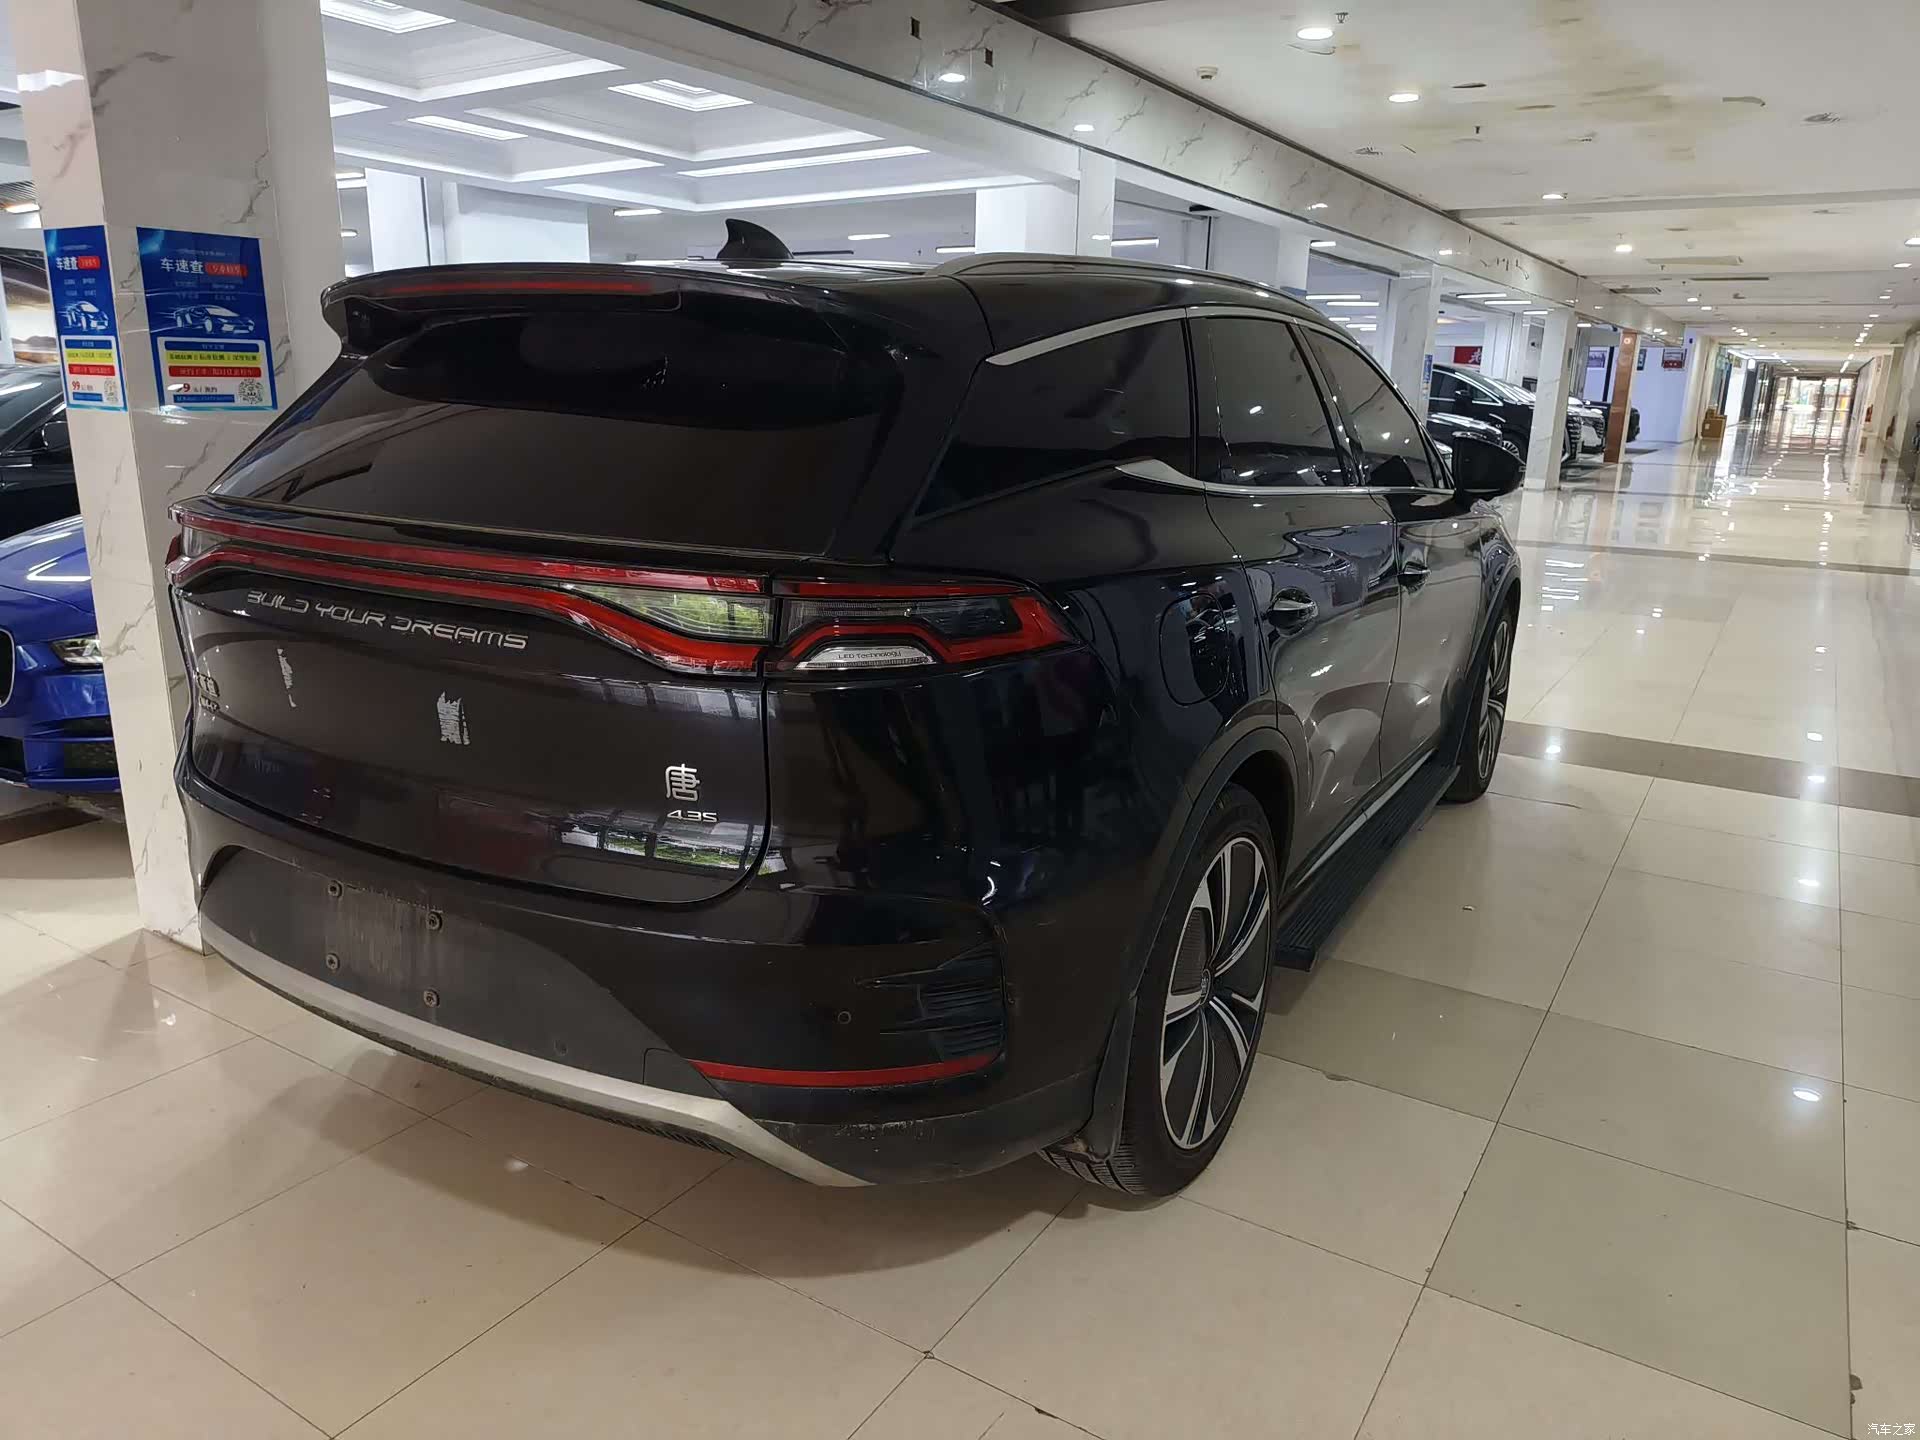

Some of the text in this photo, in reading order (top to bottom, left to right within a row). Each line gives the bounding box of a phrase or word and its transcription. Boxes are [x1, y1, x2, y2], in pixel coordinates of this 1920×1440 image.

[160, 257, 204, 274] 车速查
[247, 590, 529, 649] BUILD YOUR DREAMS
[665, 763, 700, 801] 唐
